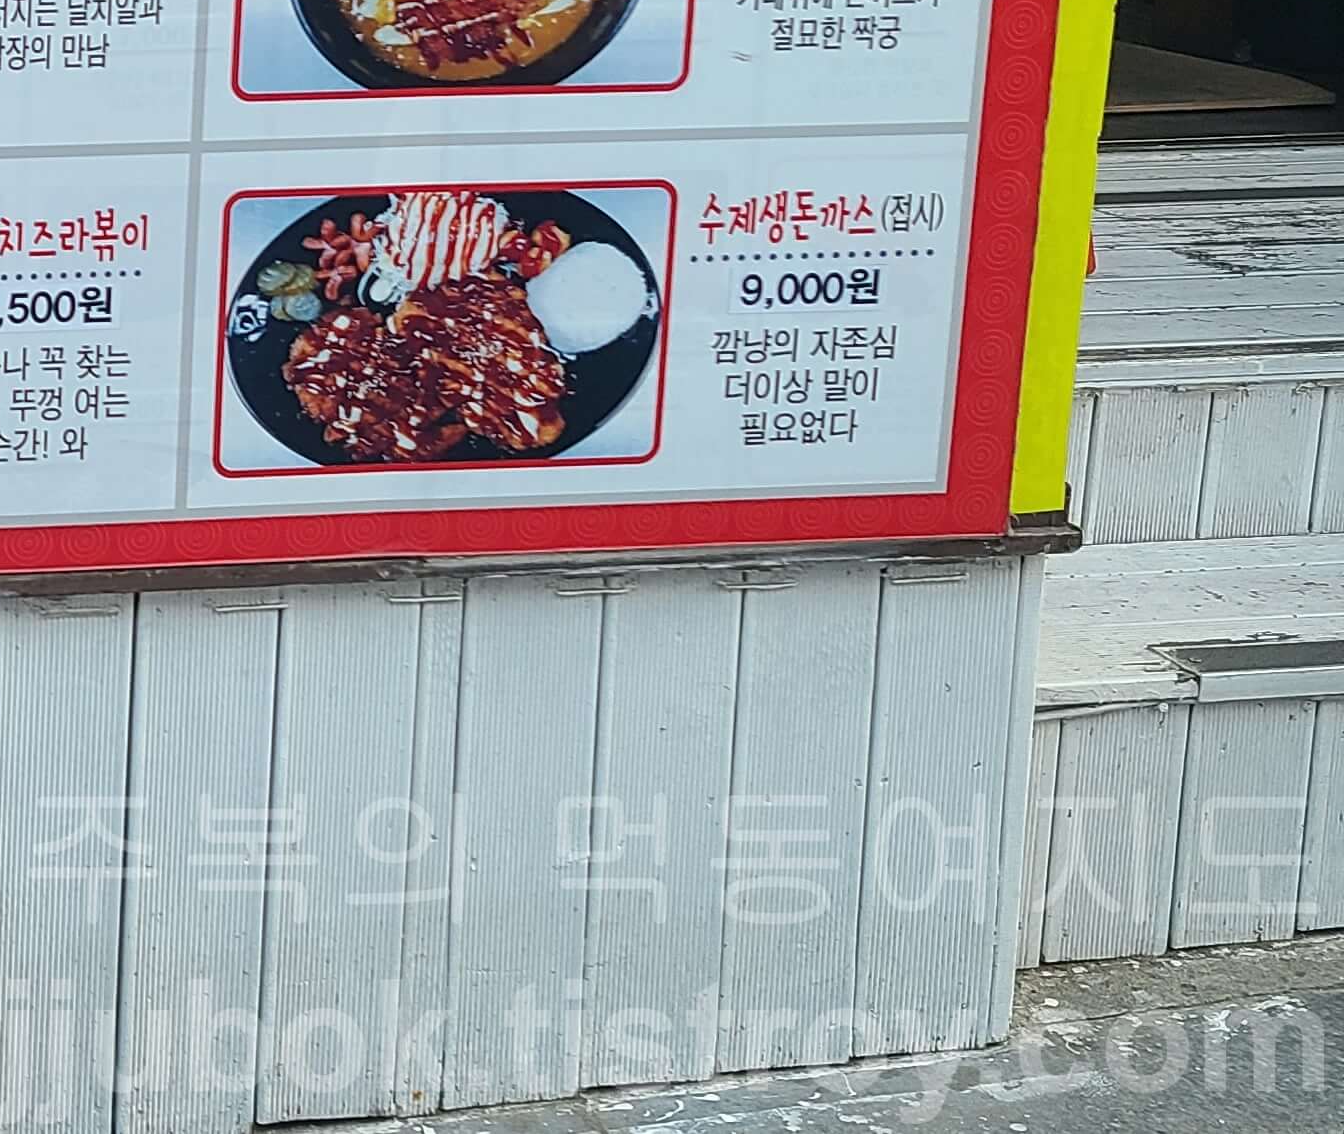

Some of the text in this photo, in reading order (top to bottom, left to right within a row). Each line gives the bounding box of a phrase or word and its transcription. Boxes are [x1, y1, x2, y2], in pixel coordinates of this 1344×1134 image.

[61, 33, 111, 69] 만남
[770, 15, 846, 52] 절묘한
[740, 267, 881, 310] 9,000원
[38, 346, 67, 381] 꼭
[75, 344, 132, 380] 찾는
[710, 324, 898, 365] 깜냥의 자존심
[9, 387, 64, 423] 뚜껑
[74, 385, 131, 419] 여는
[724, 367, 880, 406] 더이상 말이
[59, 425, 89, 461] 와
[739, 408, 859, 447] 필요없다
